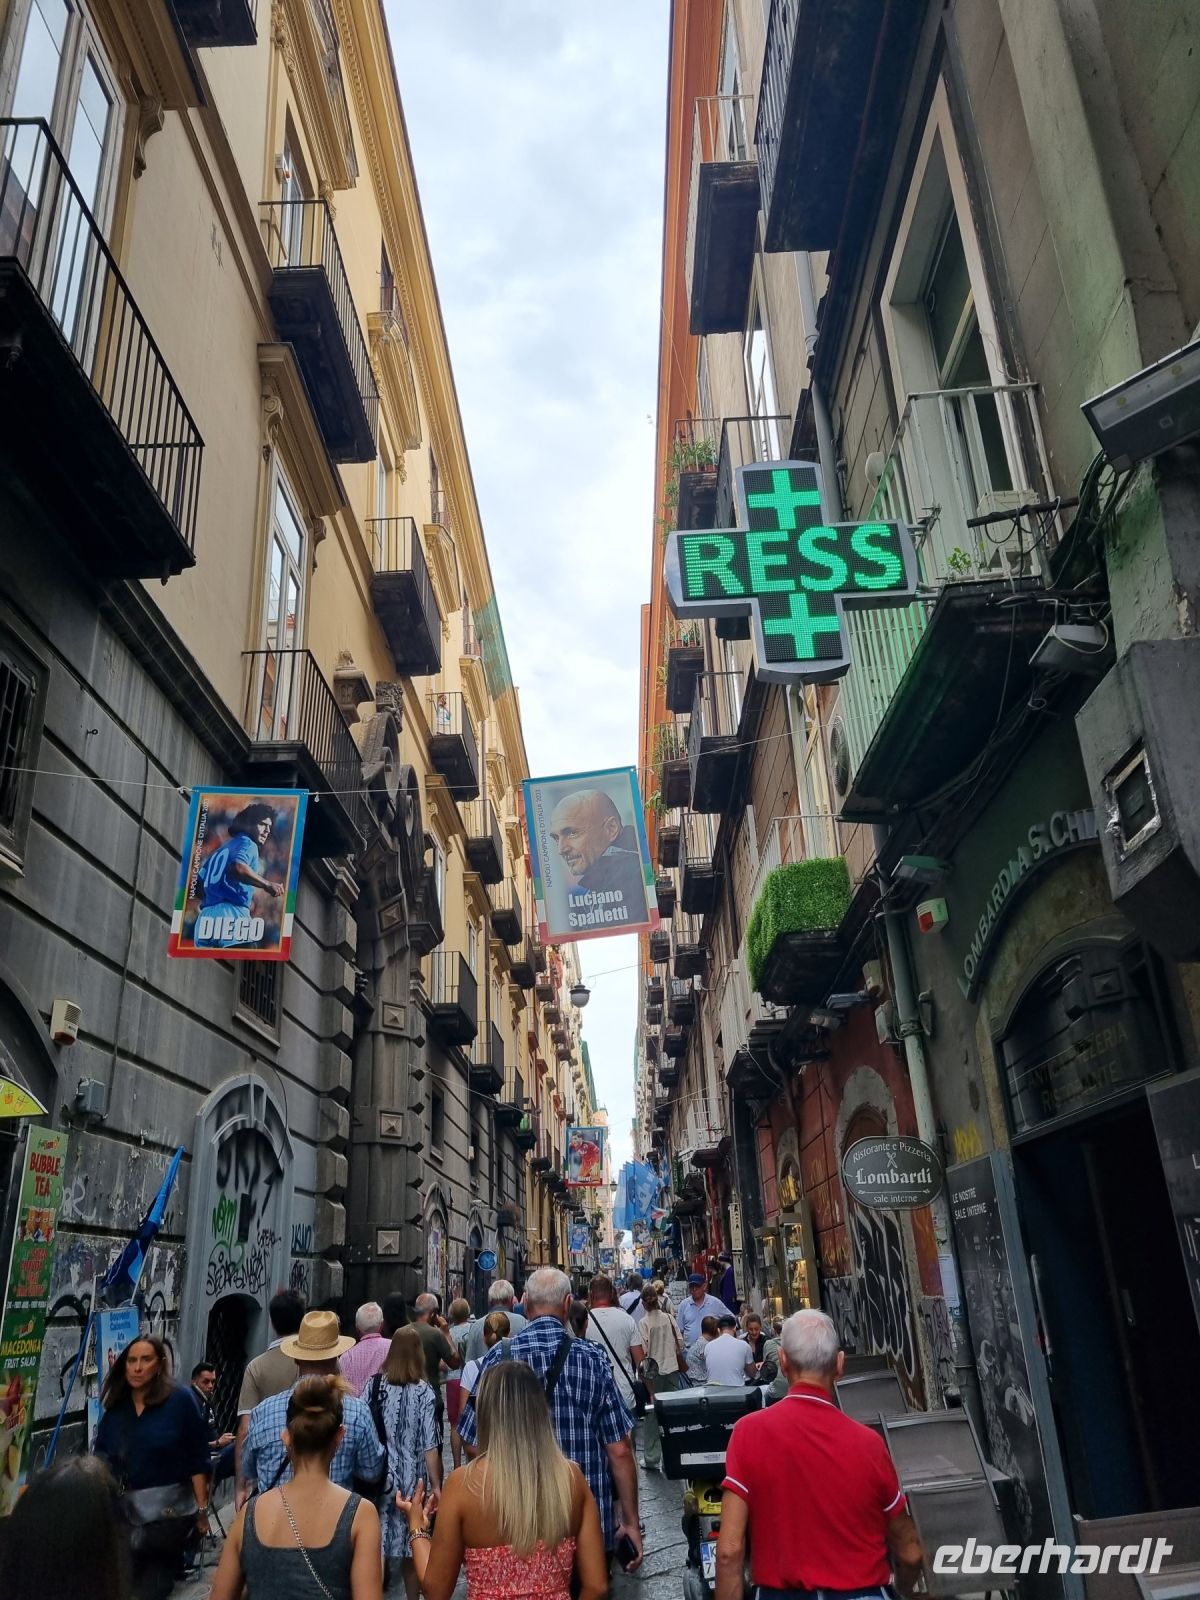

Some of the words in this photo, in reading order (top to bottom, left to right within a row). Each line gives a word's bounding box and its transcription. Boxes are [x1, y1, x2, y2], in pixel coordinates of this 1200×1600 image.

[684, 523, 902, 596] RESS
[568, 889, 623, 908] Luciano
[568, 905, 629, 927] Spalletti
[198, 916, 265, 942] DIEGO
[852, 1142, 890, 1164] Ristorante
[899, 1142, 932, 1163] Pizzeria
[29, 1152, 61, 1177] BUBBLE
[855, 1167, 933, 1185] Lombardi
[34, 1175, 51, 1198] TEA
[873, 1194, 888, 1203] sale
[890, 1194, 918, 1203] interne
[952, 1193, 959, 1204] LE
[954, 1207, 966, 1220] SALE
[20, 1356, 36, 1368] SALAD
